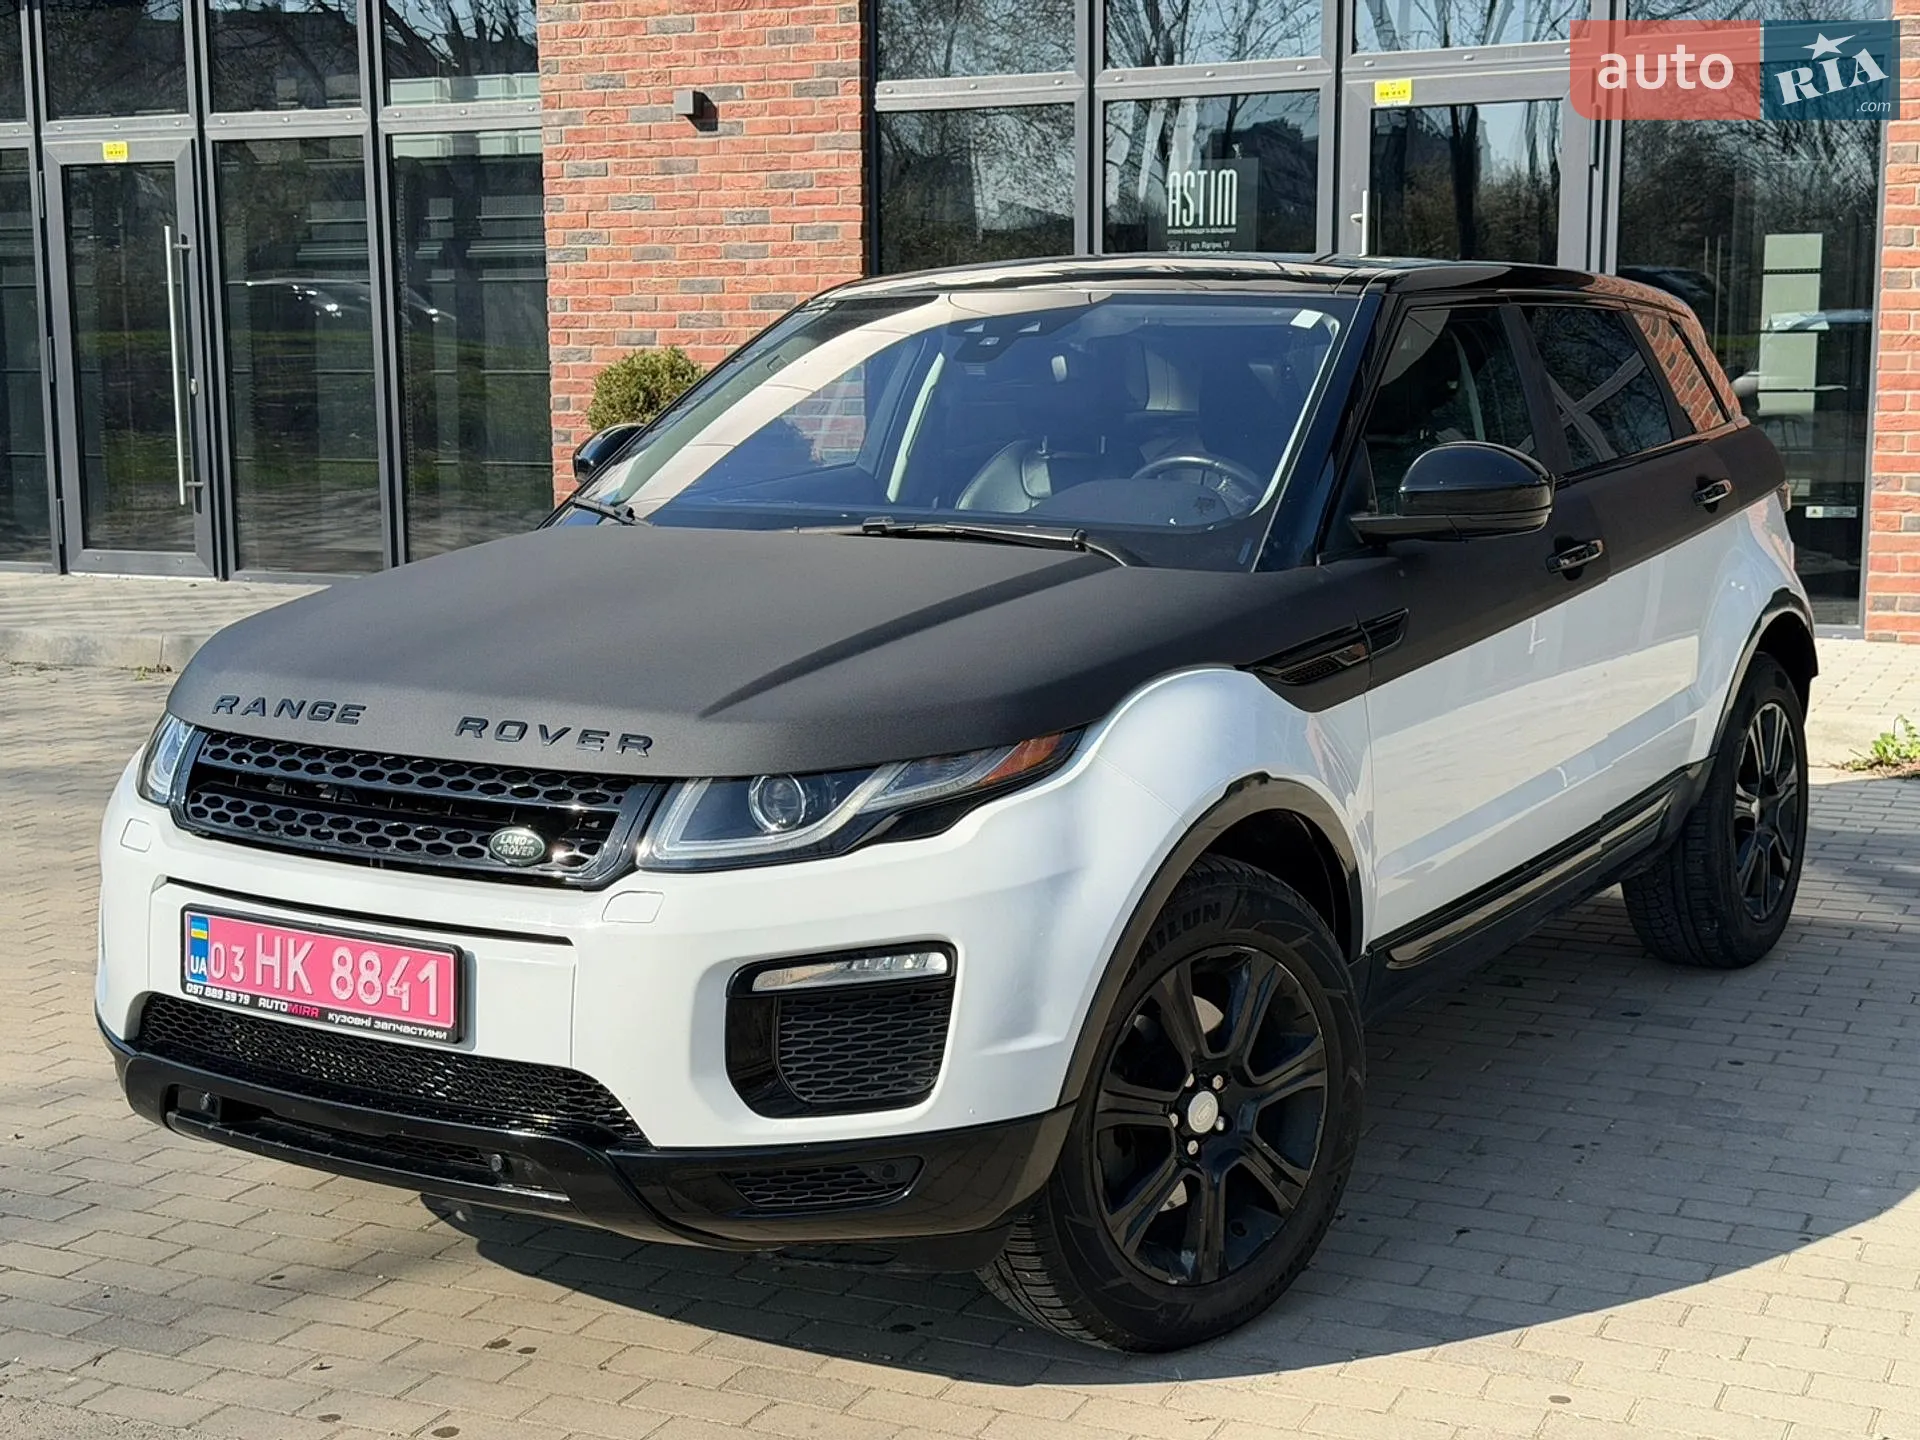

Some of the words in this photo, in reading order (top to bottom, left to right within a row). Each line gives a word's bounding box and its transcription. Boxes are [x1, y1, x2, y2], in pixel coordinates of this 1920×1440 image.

[1167, 168, 1238, 227] ASTIM
[212, 694, 367, 725] RANGE
[455, 716, 653, 757] ROVER
[500, 834, 527, 846] LAND
[501, 844, 535, 857] ROVER
[190, 954, 207, 976] UA
[1126, 901, 1221, 983] AILUN
[210, 942, 246, 984] 03
[330, 946, 438, 1016] 8841
[186, 983, 203, 995] 097
[204, 986, 224, 999] 889
[224, 991, 238, 1002] 59
[238, 993, 251, 1006] 79
[327, 1011, 372, 1028] кузовні
[373, 1020, 448, 1040] запчастини
